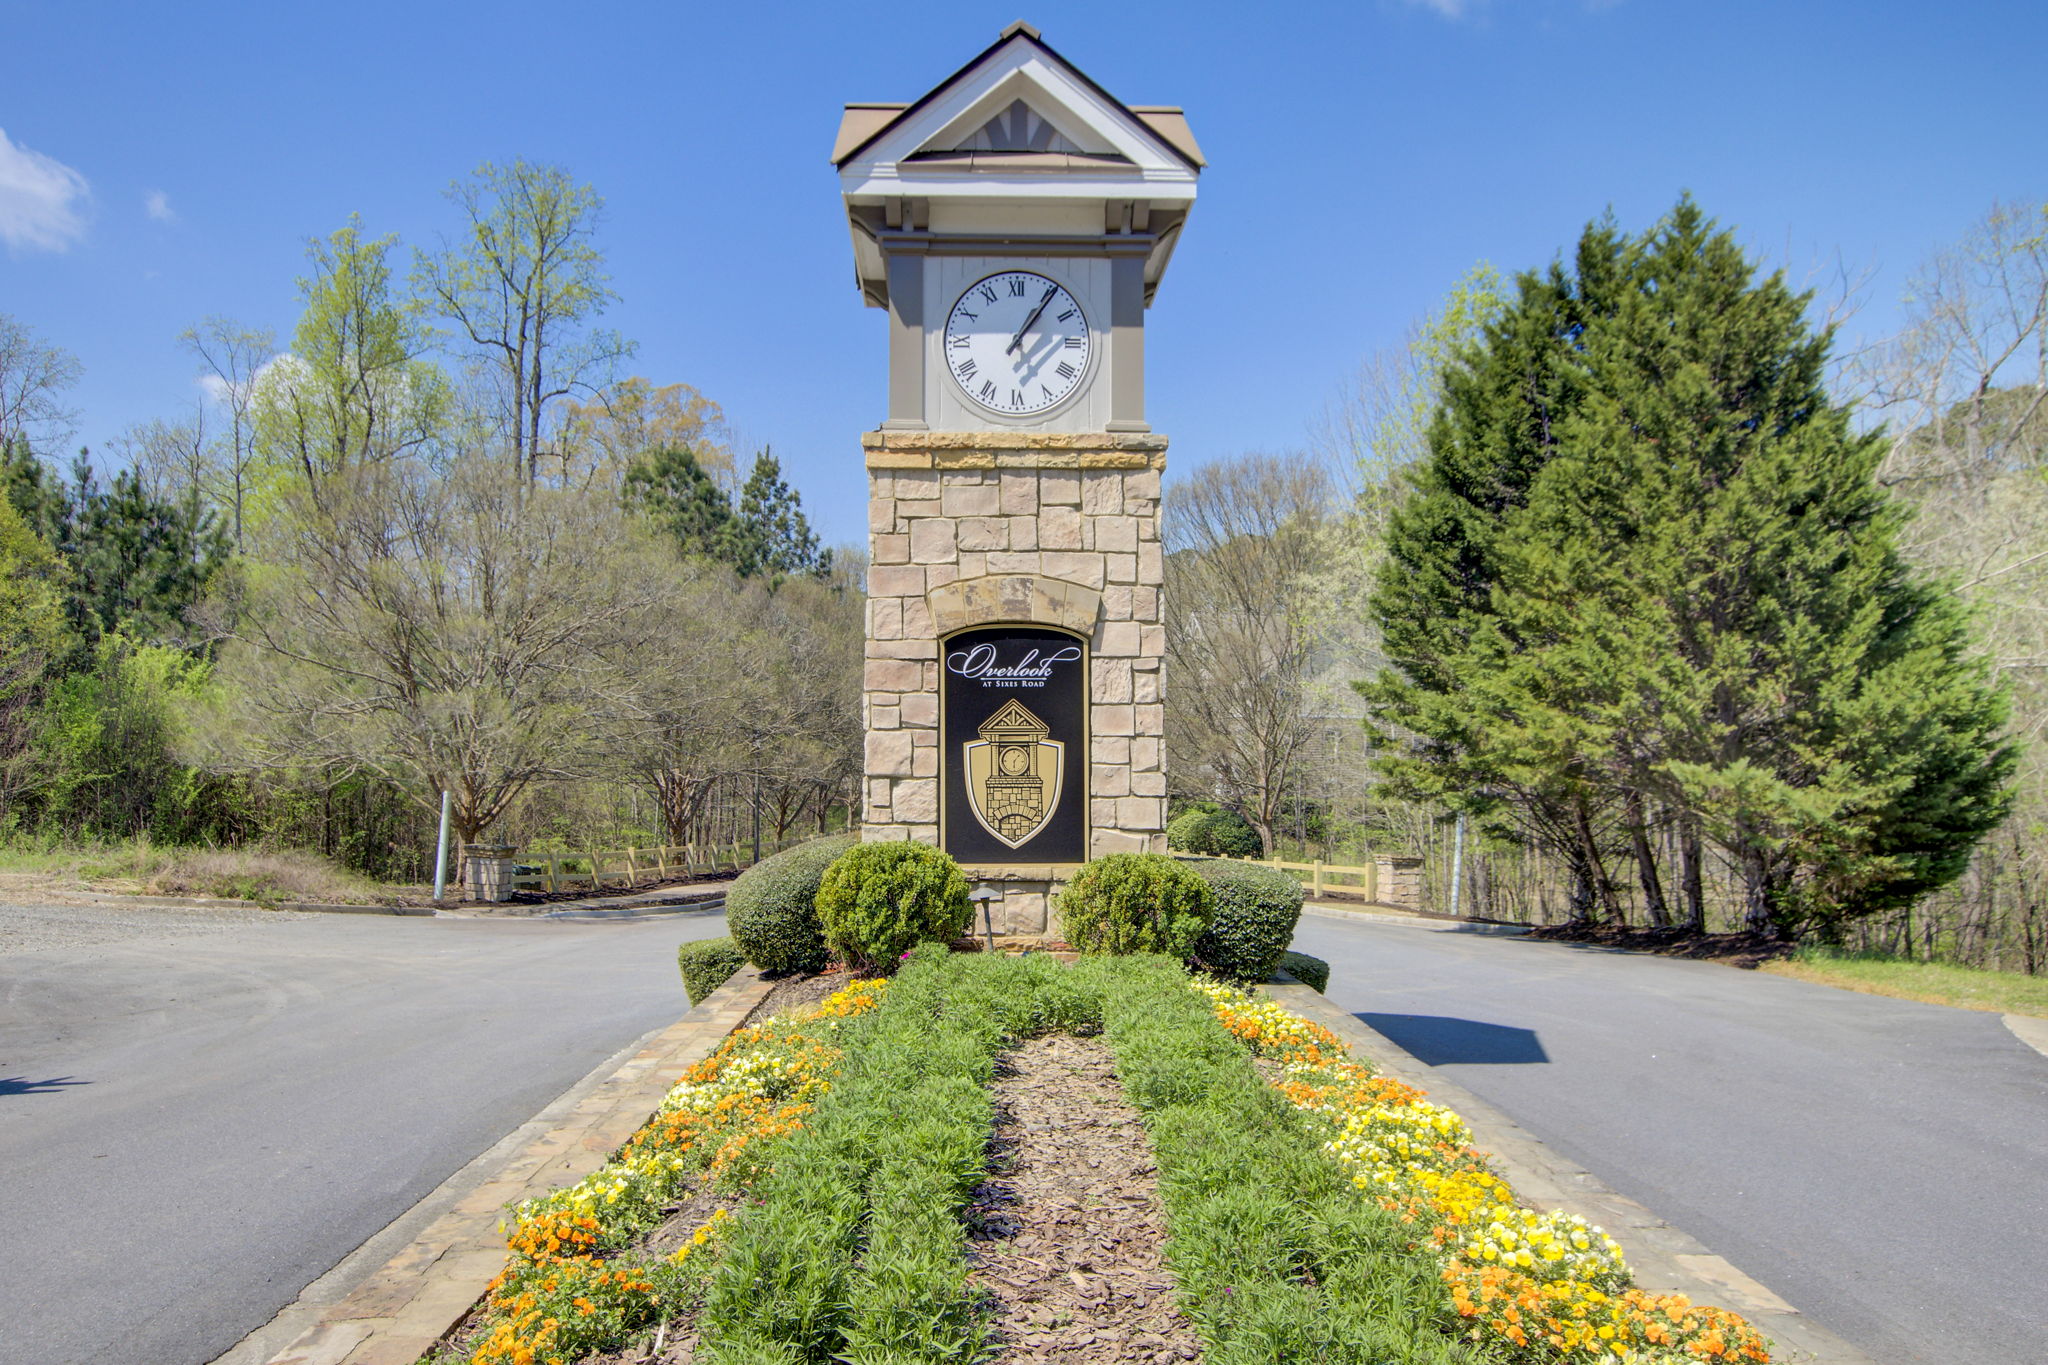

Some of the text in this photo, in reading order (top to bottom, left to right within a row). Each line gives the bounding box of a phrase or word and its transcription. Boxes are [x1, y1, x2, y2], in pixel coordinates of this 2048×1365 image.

[980, 285, 998, 306] XI
[1008, 280, 1025, 298] XII
[960, 306, 978, 323] X
[1057, 309, 1074, 323] II
[953, 335, 970, 349] IX
[1064, 337, 1081, 349] III
[958, 358, 978, 382] VIII
[980, 379, 997, 401] VII
[1011, 389, 1024, 406] VI
[1041, 383, 1054, 400] V
[947, 643, 1082, 679] Overlook
